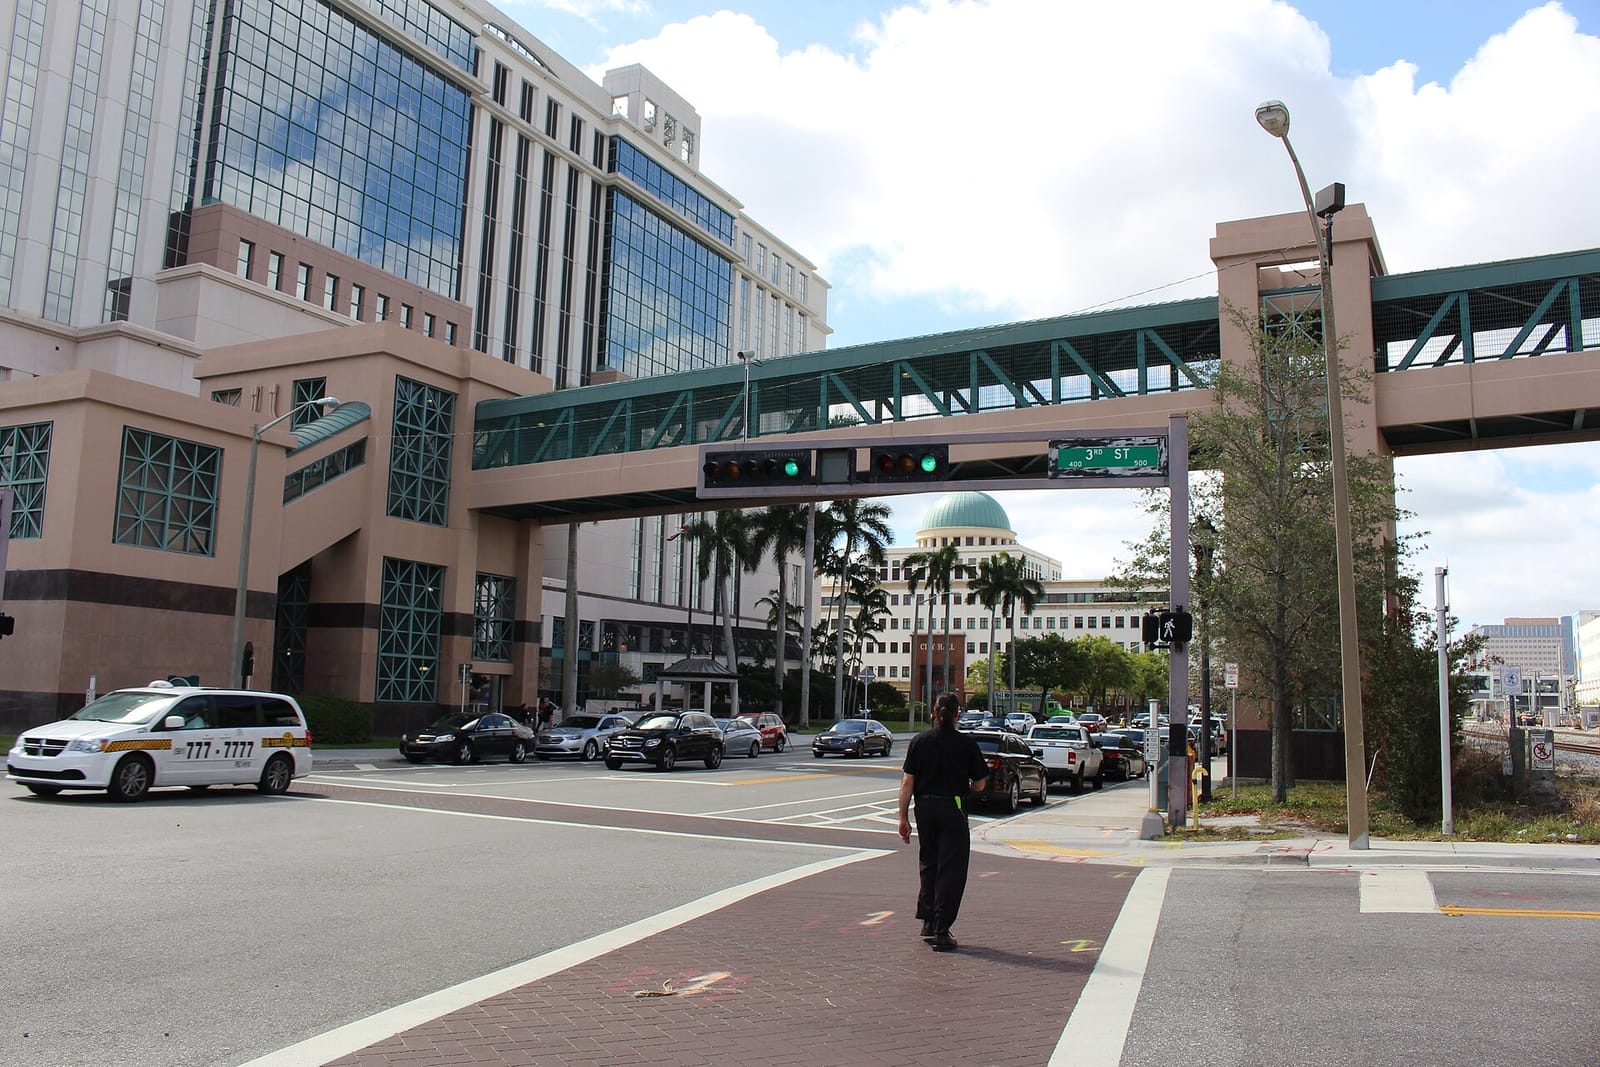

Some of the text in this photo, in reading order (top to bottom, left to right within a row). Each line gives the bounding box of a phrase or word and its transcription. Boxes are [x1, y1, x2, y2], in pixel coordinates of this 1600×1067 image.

[1085, 448, 1130, 461] 3RD ST
[1068, 460, 1083, 468] 400
[1134, 459, 1148, 467] 500
[920, 642, 955, 651] CIY HL
[186, 741, 211, 759] 777
[224, 740, 254, 758] 7777
